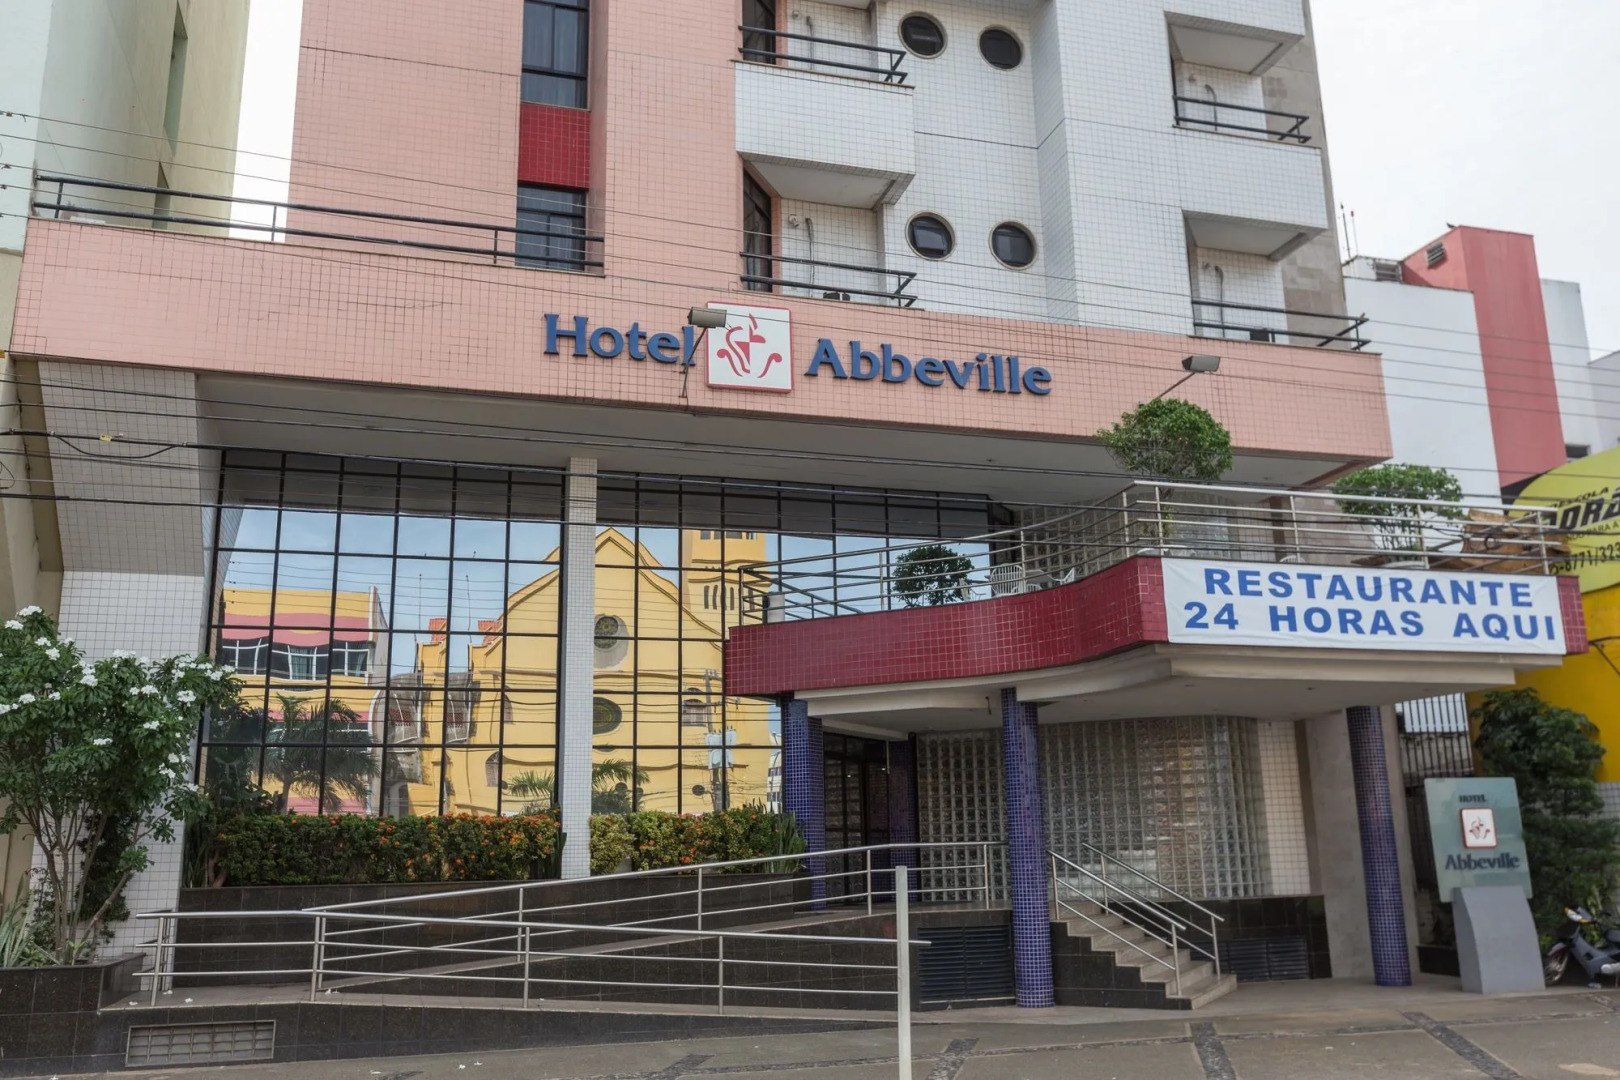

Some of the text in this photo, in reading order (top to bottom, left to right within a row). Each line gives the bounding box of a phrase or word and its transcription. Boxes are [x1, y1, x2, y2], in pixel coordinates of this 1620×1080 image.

[542, 312, 1053, 396] Hotel Abbeville
[1204, 567, 1533, 608] RESTAURANTE
[1184, 602, 1556, 641] 24 HORAS AQUI
[1445, 853, 1520, 871] Abbeville
